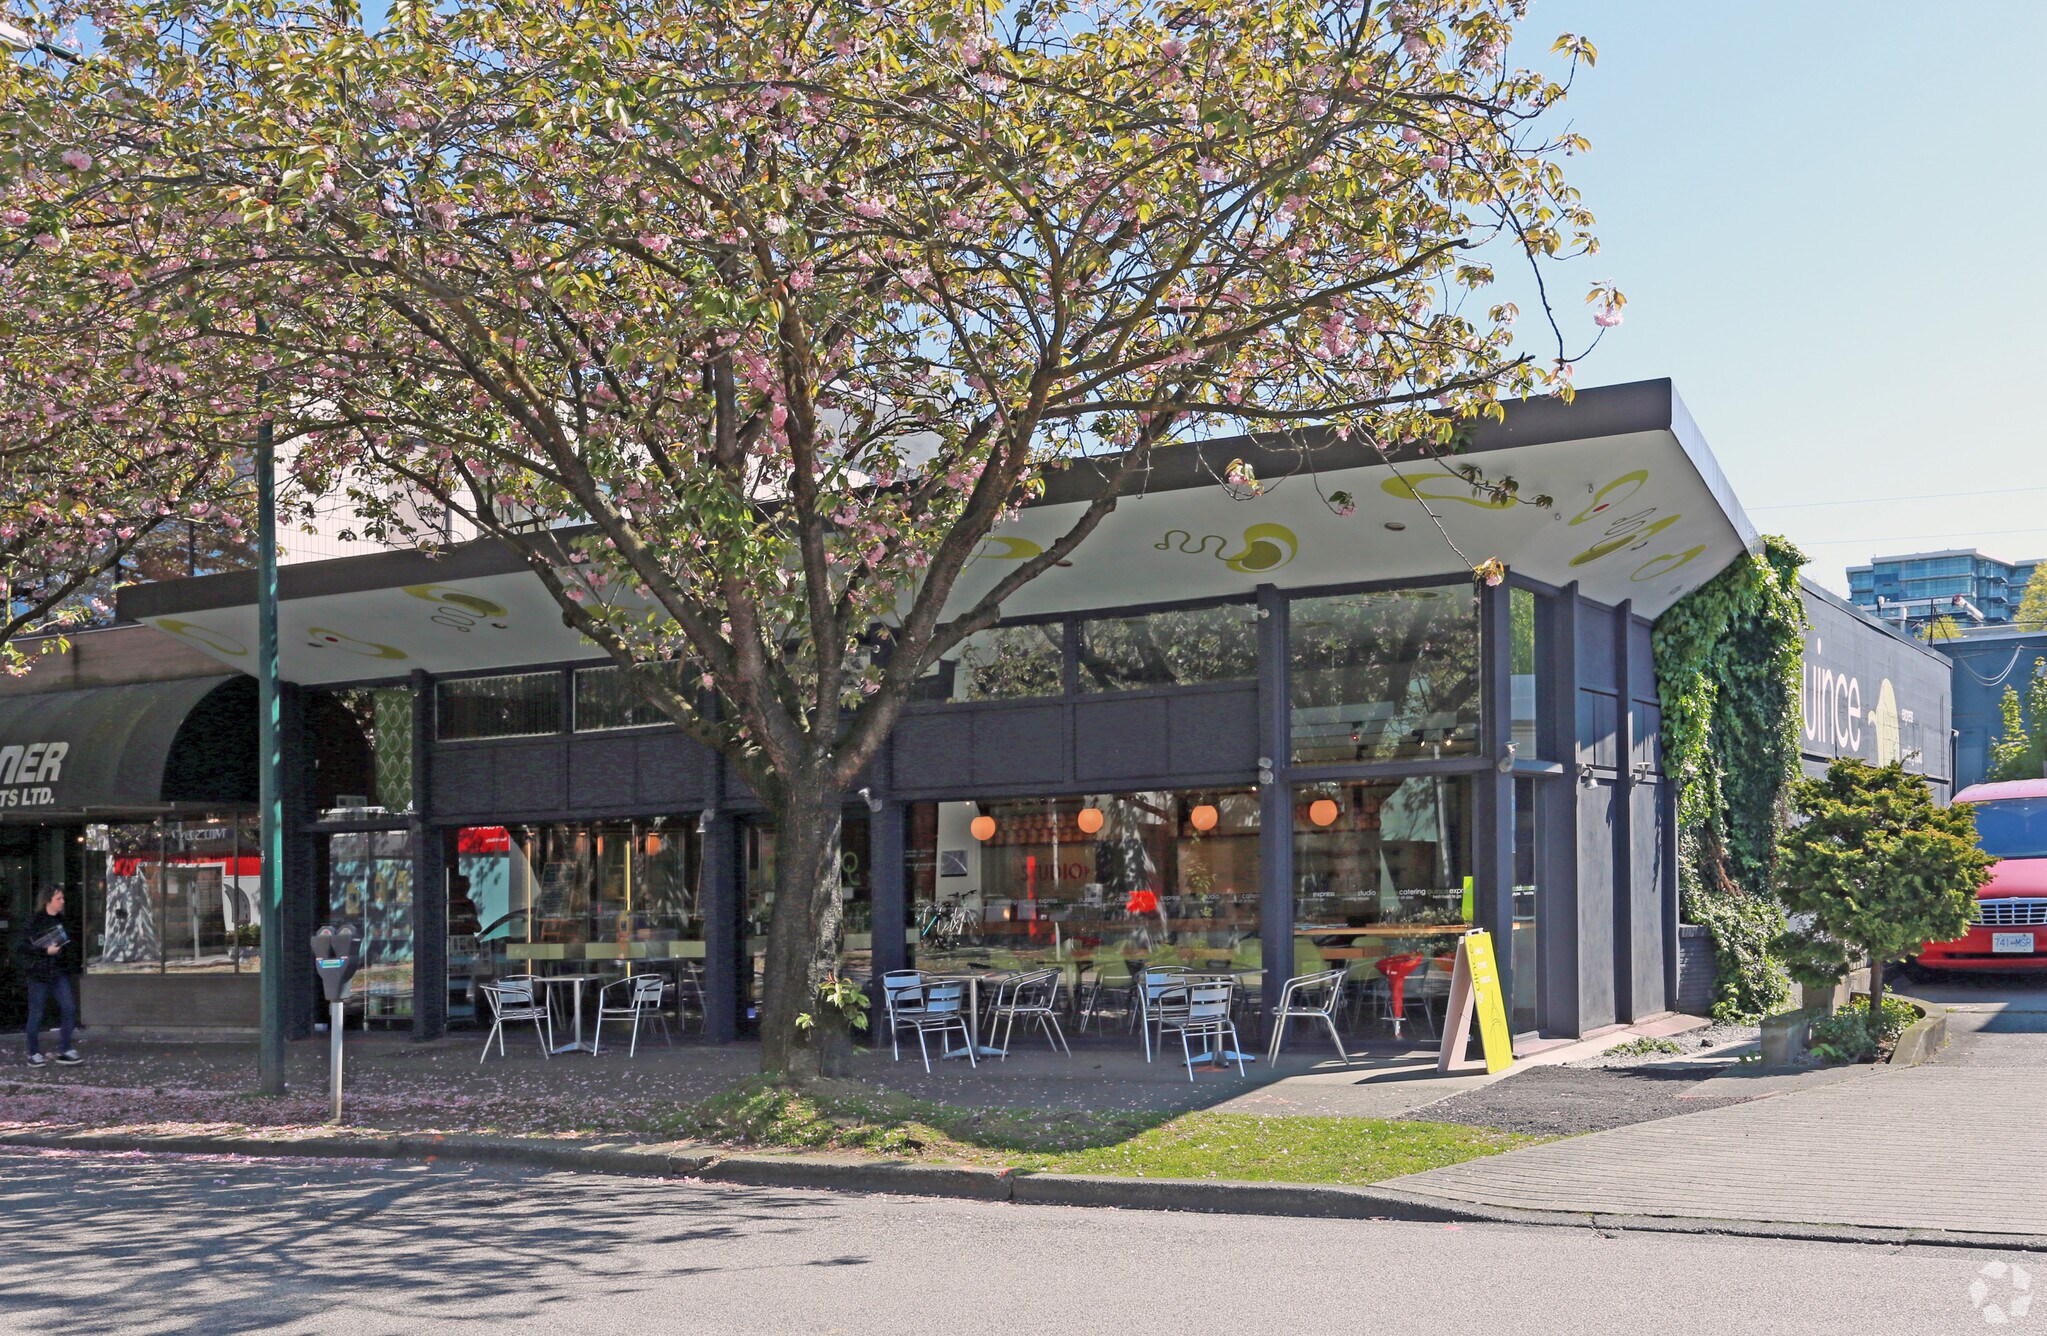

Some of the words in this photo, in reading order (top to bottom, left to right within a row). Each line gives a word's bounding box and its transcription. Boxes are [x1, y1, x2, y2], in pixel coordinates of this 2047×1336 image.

[0, 789, 18, 807] TS
[21, 787, 55, 806] LTD.
[1399, 888, 1426, 896] catering
